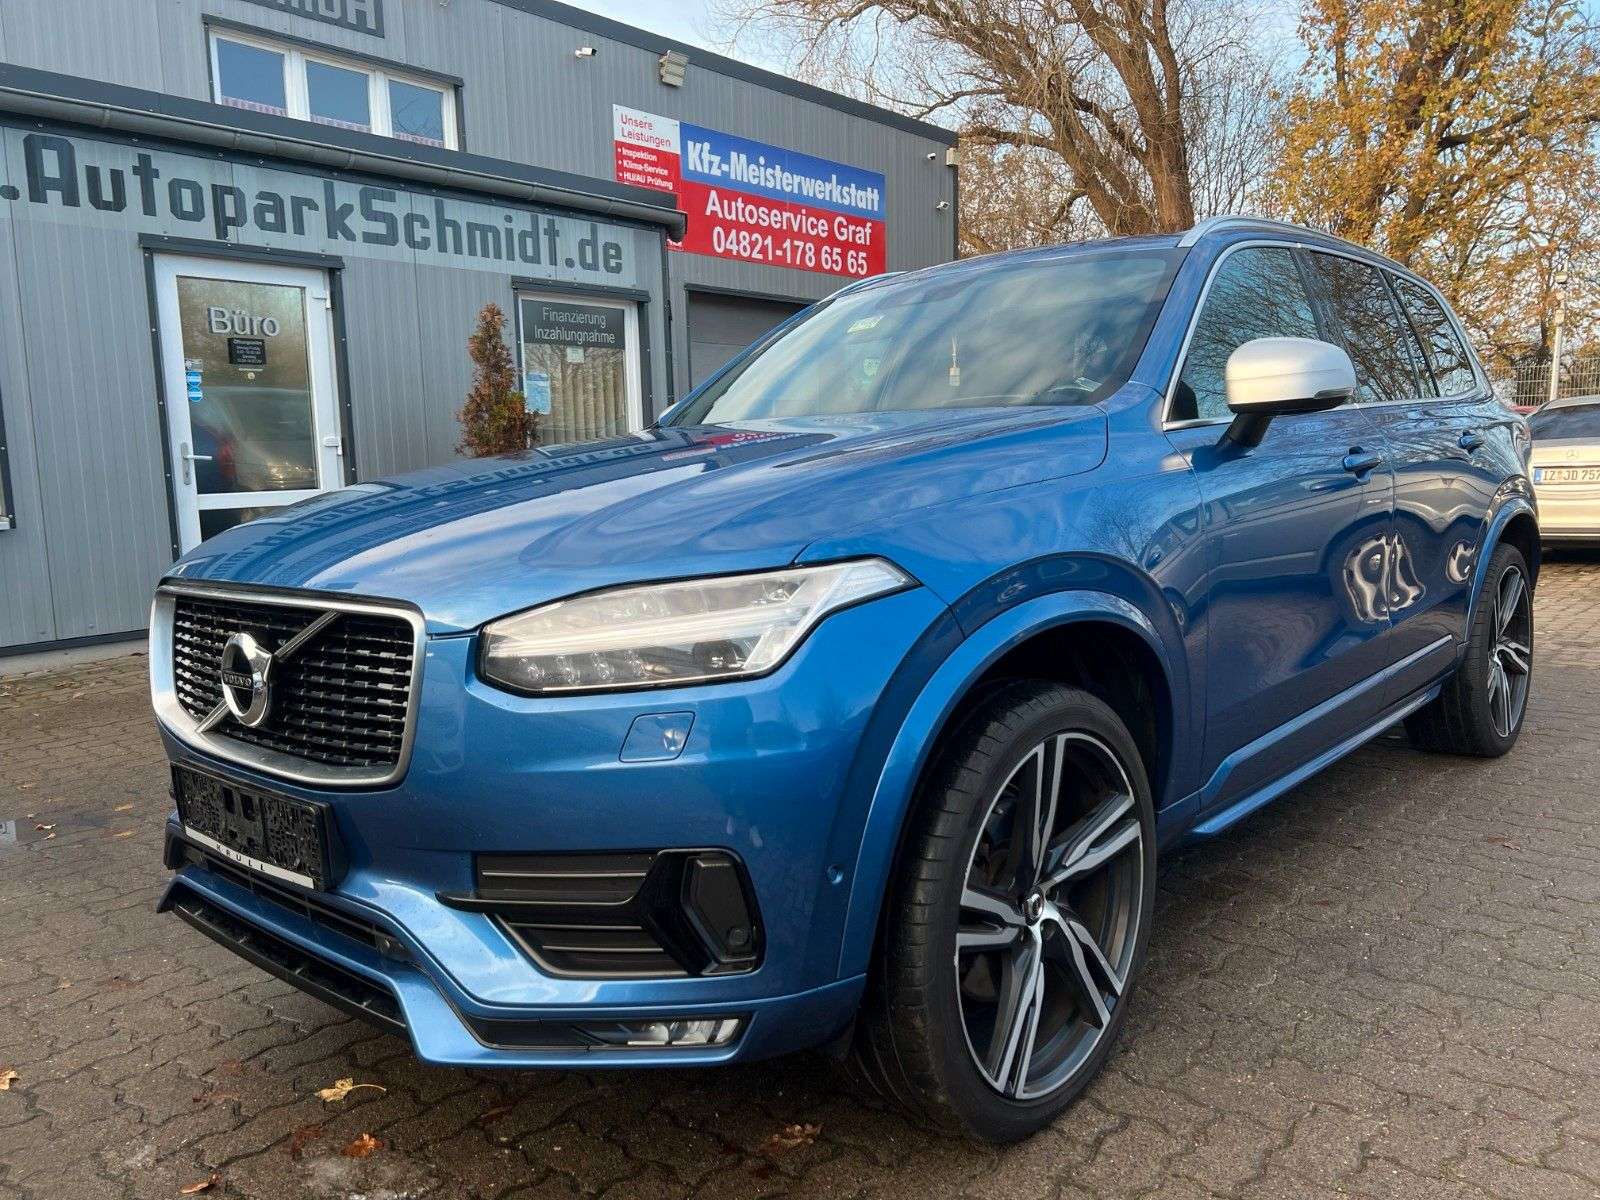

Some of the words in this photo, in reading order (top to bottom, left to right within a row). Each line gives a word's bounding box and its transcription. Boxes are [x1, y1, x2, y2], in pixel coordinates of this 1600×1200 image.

[620, 113, 653, 131] Unsere
[621, 127, 671, 147] Leistungen
[622, 147, 658, 162] Inspektion
[623, 159, 668, 176] Klima-Service
[687, 140, 880, 212] Kfz-Meisterwerkstatt
[623, 171, 646, 184] HU/AU
[647, 175, 673, 191] Prüfung
[705, 190, 829, 238] Autoservice
[834, 215, 872, 246] Graf
[712, 226, 815, 268] 04821-178
[821, 245, 842, 272] 65
[847, 249, 868, 276] 65
[208, 307, 280, 337] Büro
[542, 306, 606, 328] Finanzierung
[534, 324, 616, 344] Inzahlungnahme
